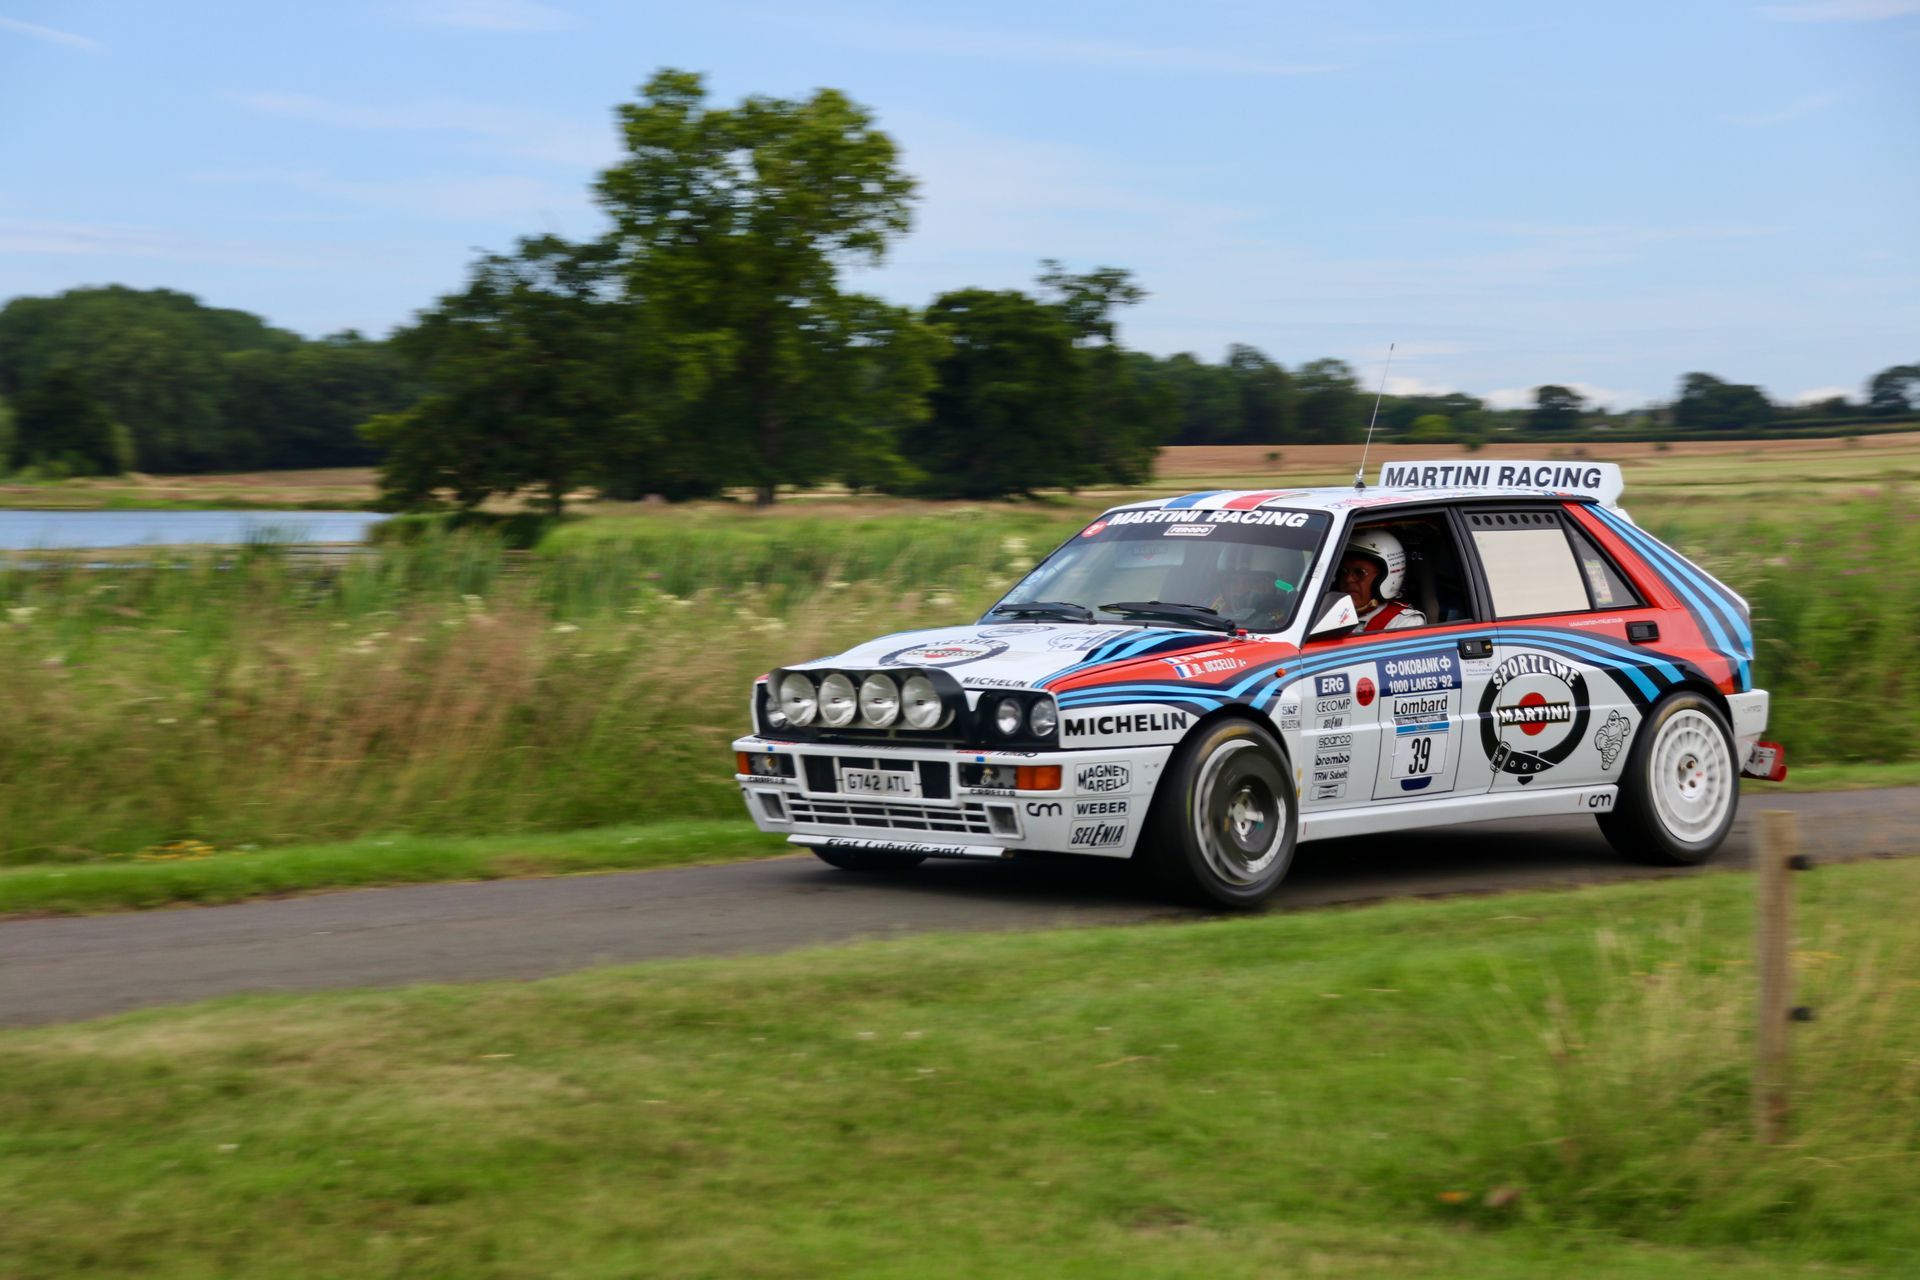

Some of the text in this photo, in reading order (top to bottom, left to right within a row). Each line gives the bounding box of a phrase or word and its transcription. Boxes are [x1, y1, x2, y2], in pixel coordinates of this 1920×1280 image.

[1384, 465, 1602, 489] MARTINI RACING
[1107, 510, 1310, 528] MARTINI RACING
[1397, 657, 1441, 676] OKOBANK
[1492, 654, 1580, 691] SPORTLINE
[962, 676, 1028, 688] MICHELIN
[1321, 677, 1345, 694] ERG
[1389, 679, 1409, 694] 1000
[1410, 676, 1438, 691] LAKES
[1316, 698, 1351, 713] CECOMP
[1394, 695, 1448, 715] Lombard
[1498, 705, 1570, 723] MARTINI
[1064, 712, 1187, 737] MICHELIN
[1318, 735, 1351, 748] sparco
[1315, 753, 1350, 766] brembo
[1408, 737, 1431, 774] 39
[848, 773, 911, 793] G742 ATL
[1314, 770, 1348, 782] TRW Sabelt
[1077, 802, 1127, 815] WEBER
